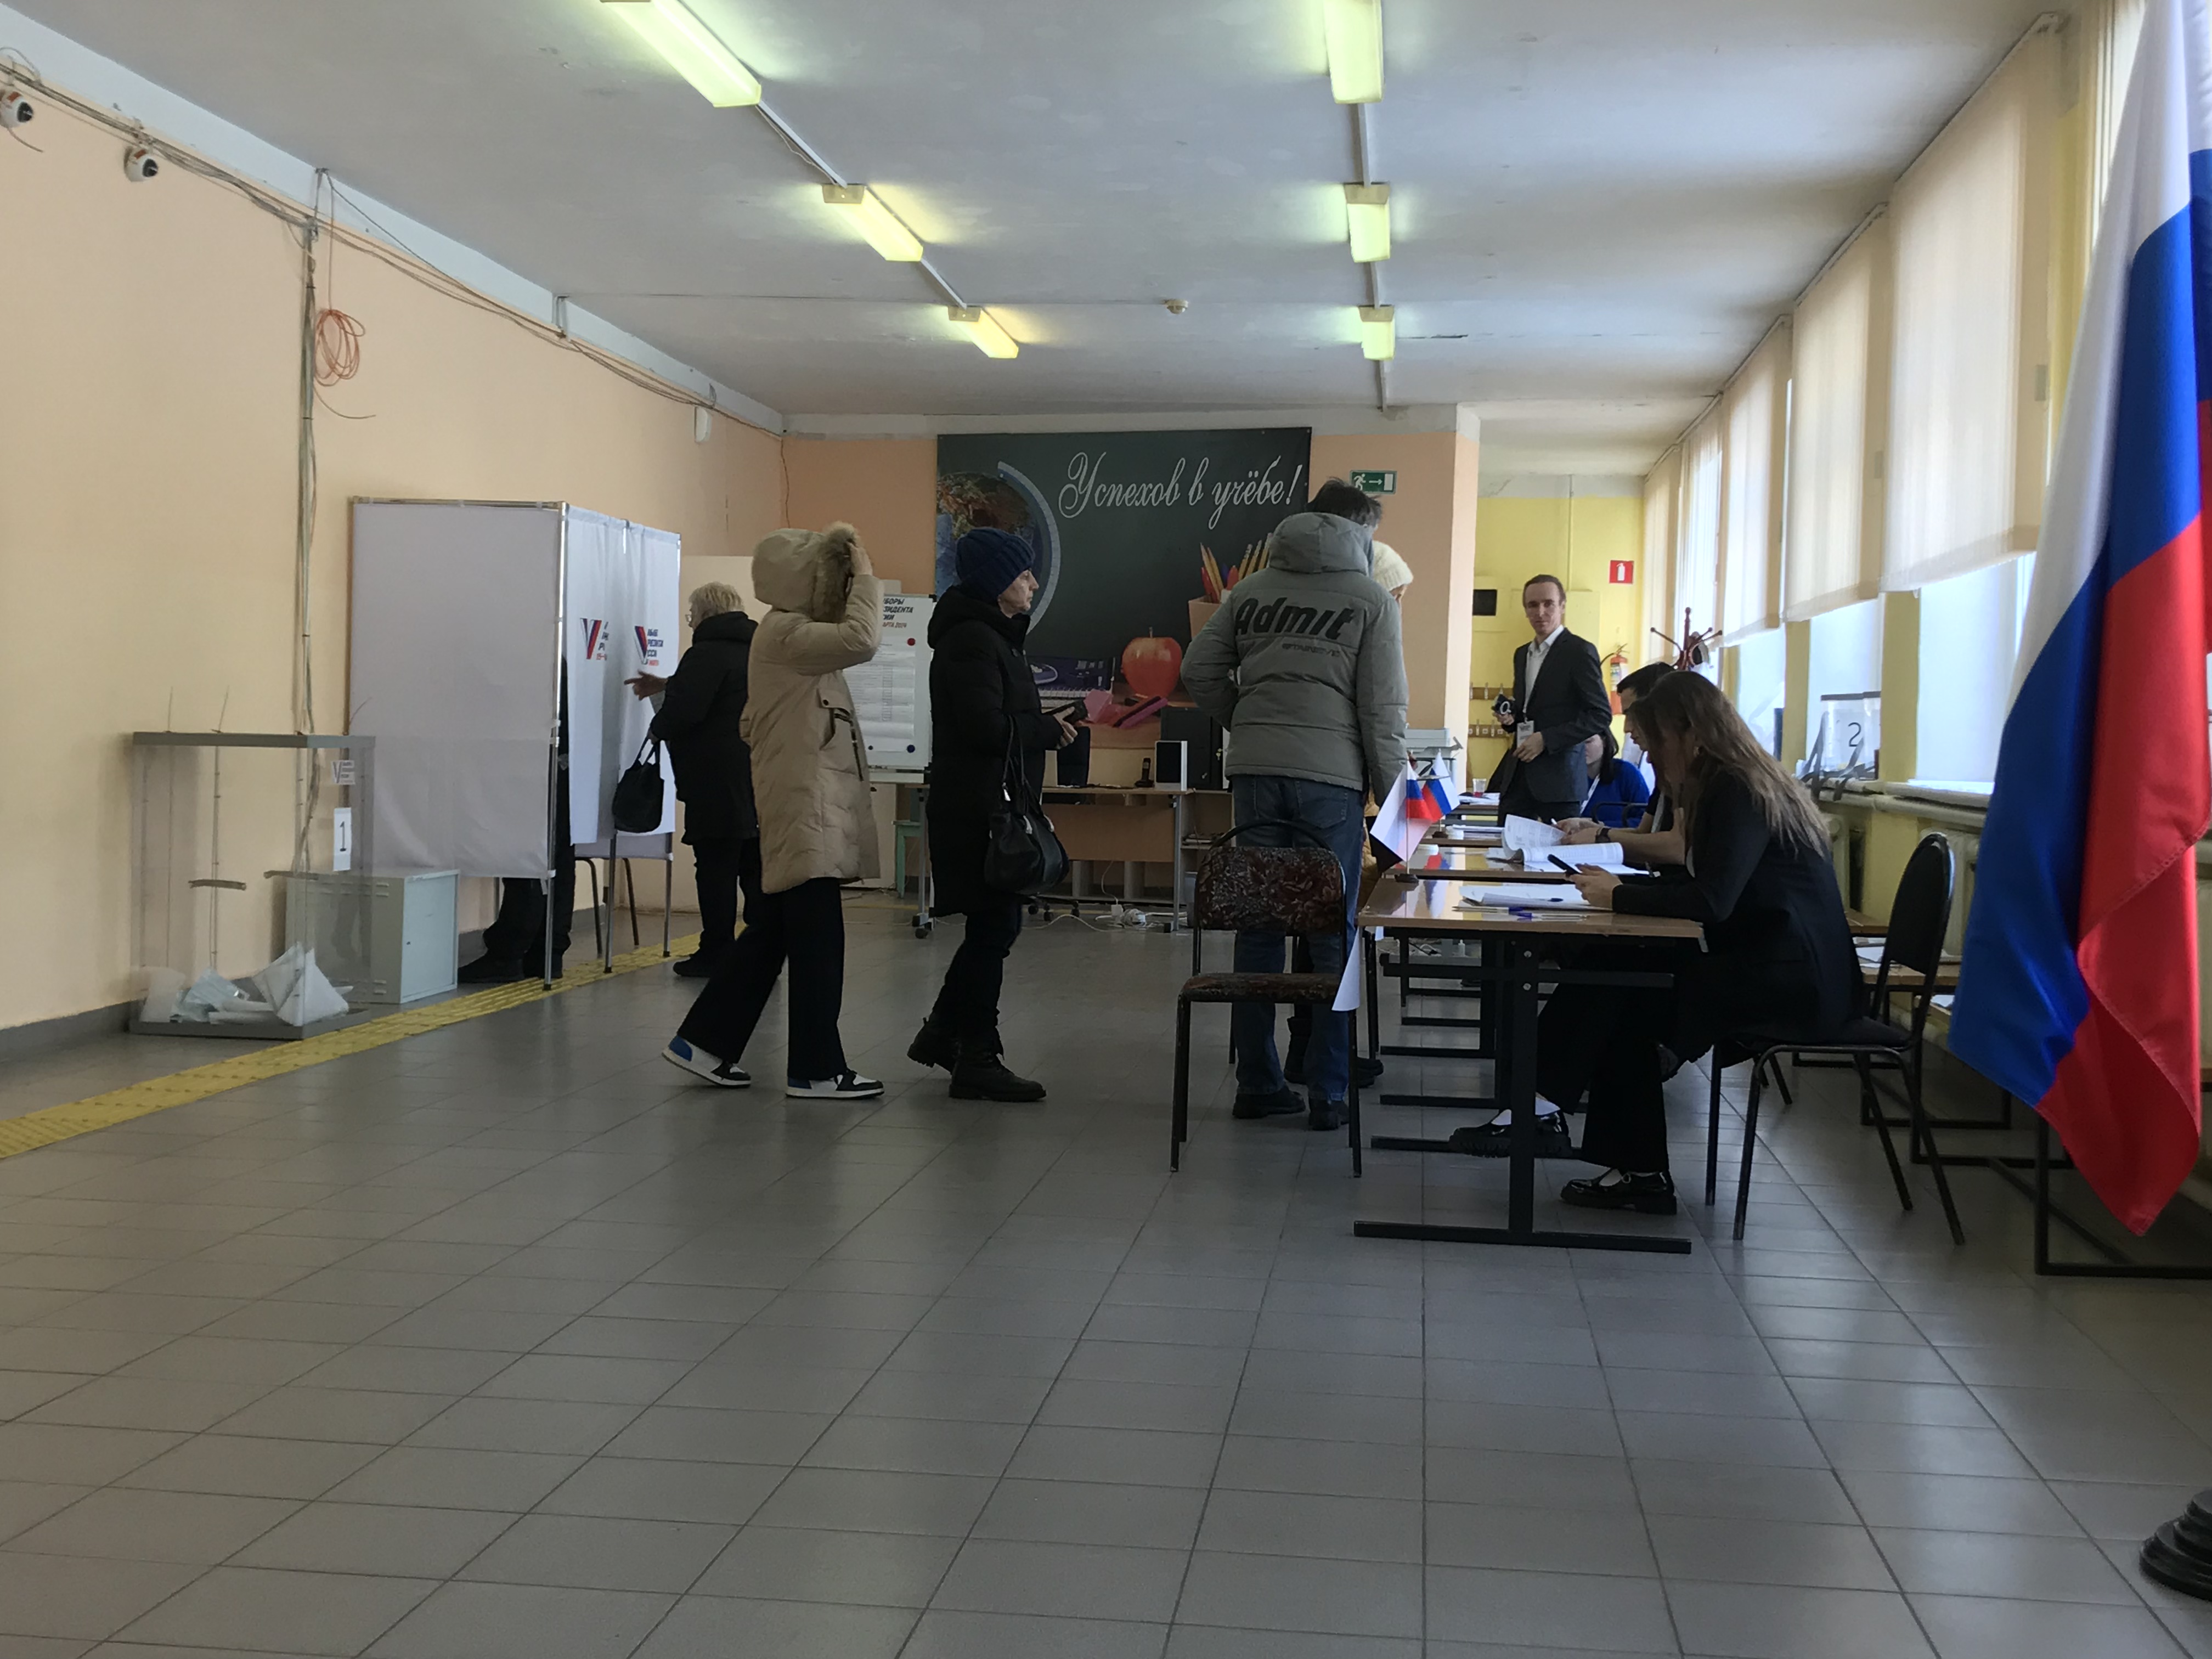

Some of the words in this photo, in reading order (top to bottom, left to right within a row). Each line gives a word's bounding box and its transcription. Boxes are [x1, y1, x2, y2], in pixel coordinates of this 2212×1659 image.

[1058, 452, 1186, 518] Успехов
[1188, 457, 1209, 506] в
[1208, 455, 1303, 530] учёбе!
[1235, 597, 1354, 640] Admit
[1848, 722, 1861, 747] 2
[340, 821, 347, 851] 1
